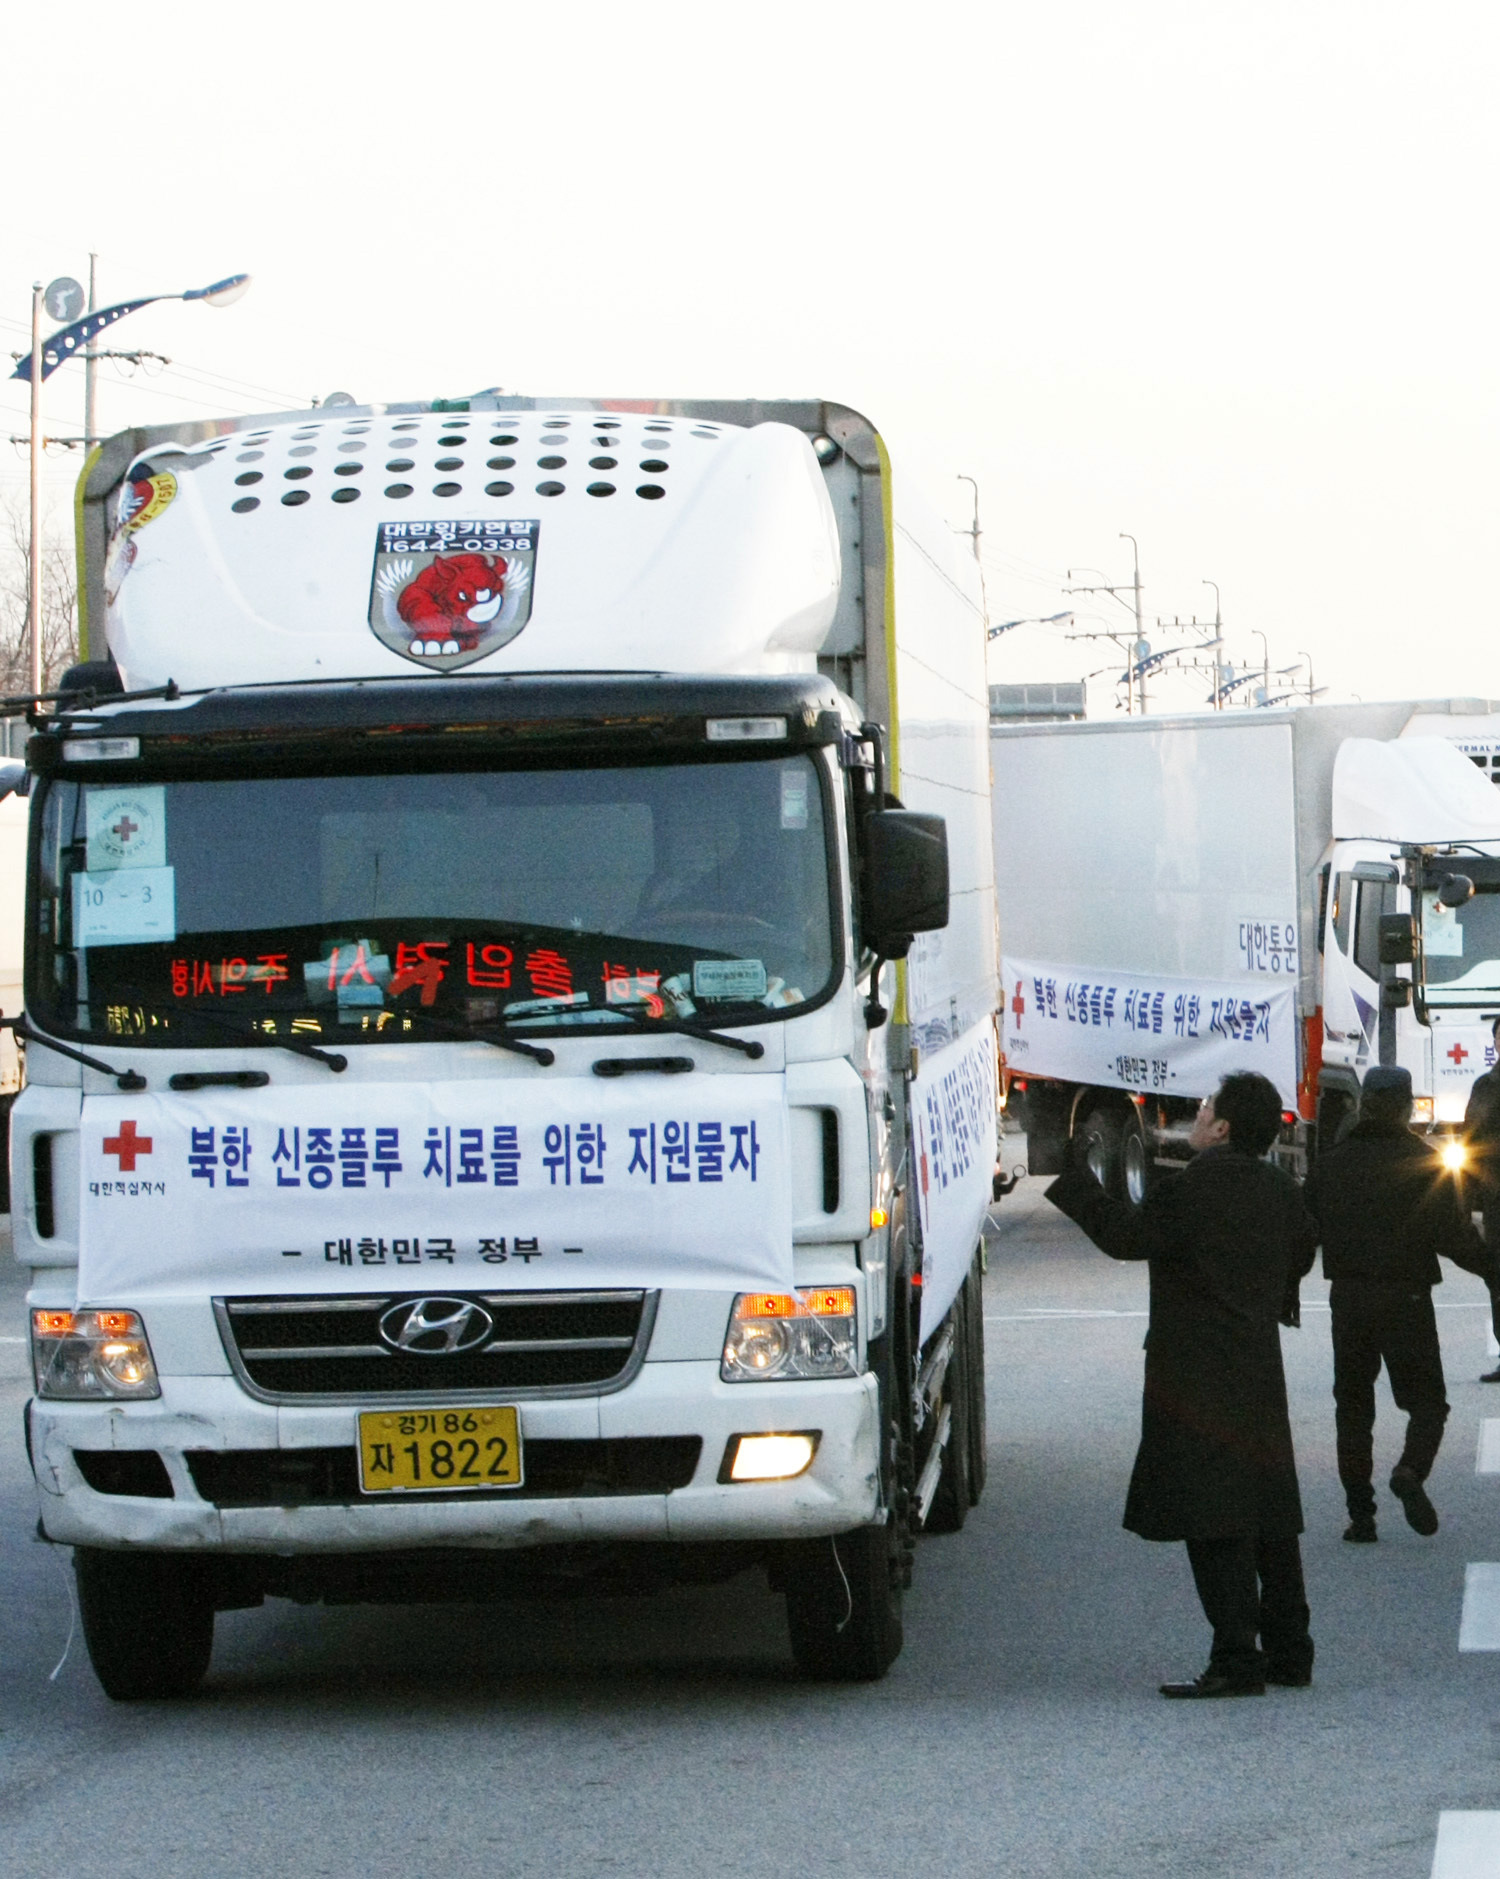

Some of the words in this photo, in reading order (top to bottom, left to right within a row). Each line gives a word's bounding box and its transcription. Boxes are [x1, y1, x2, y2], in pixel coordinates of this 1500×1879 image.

[384, 521, 533, 541] 대한윙카연합
[383, 538, 531, 552] 1644-0338
[84, 888, 104, 907] 10
[142, 886, 152, 904] 3
[1240, 922, 1296, 974] 대한통운
[1034, 977, 1057, 1019] 북한
[1065, 983, 1117, 1028] 신종플루
[1124, 989, 1165, 1034] 치료를
[1174, 994, 1201, 1037] 위한
[1210, 998, 1271, 1043] 지원물자
[1116, 1055, 1148, 1085] 대한민국
[1152, 1060, 1167, 1088] 정부
[188, 1126, 251, 1188] 북한
[272, 1126, 402, 1189] 신종플루
[423, 1125, 521, 1187] 치료를
[543, 1123, 606, 1186] 위한
[628, 1120, 760, 1184] 지원물자
[90, 1182, 165, 1196] 대한적십자사
[324, 1238, 456, 1265] 대한민국
[478, 1237, 542, 1264] 정부
[398, 1415, 436, 1435] 경기
[444, 1413, 478, 1434] 86
